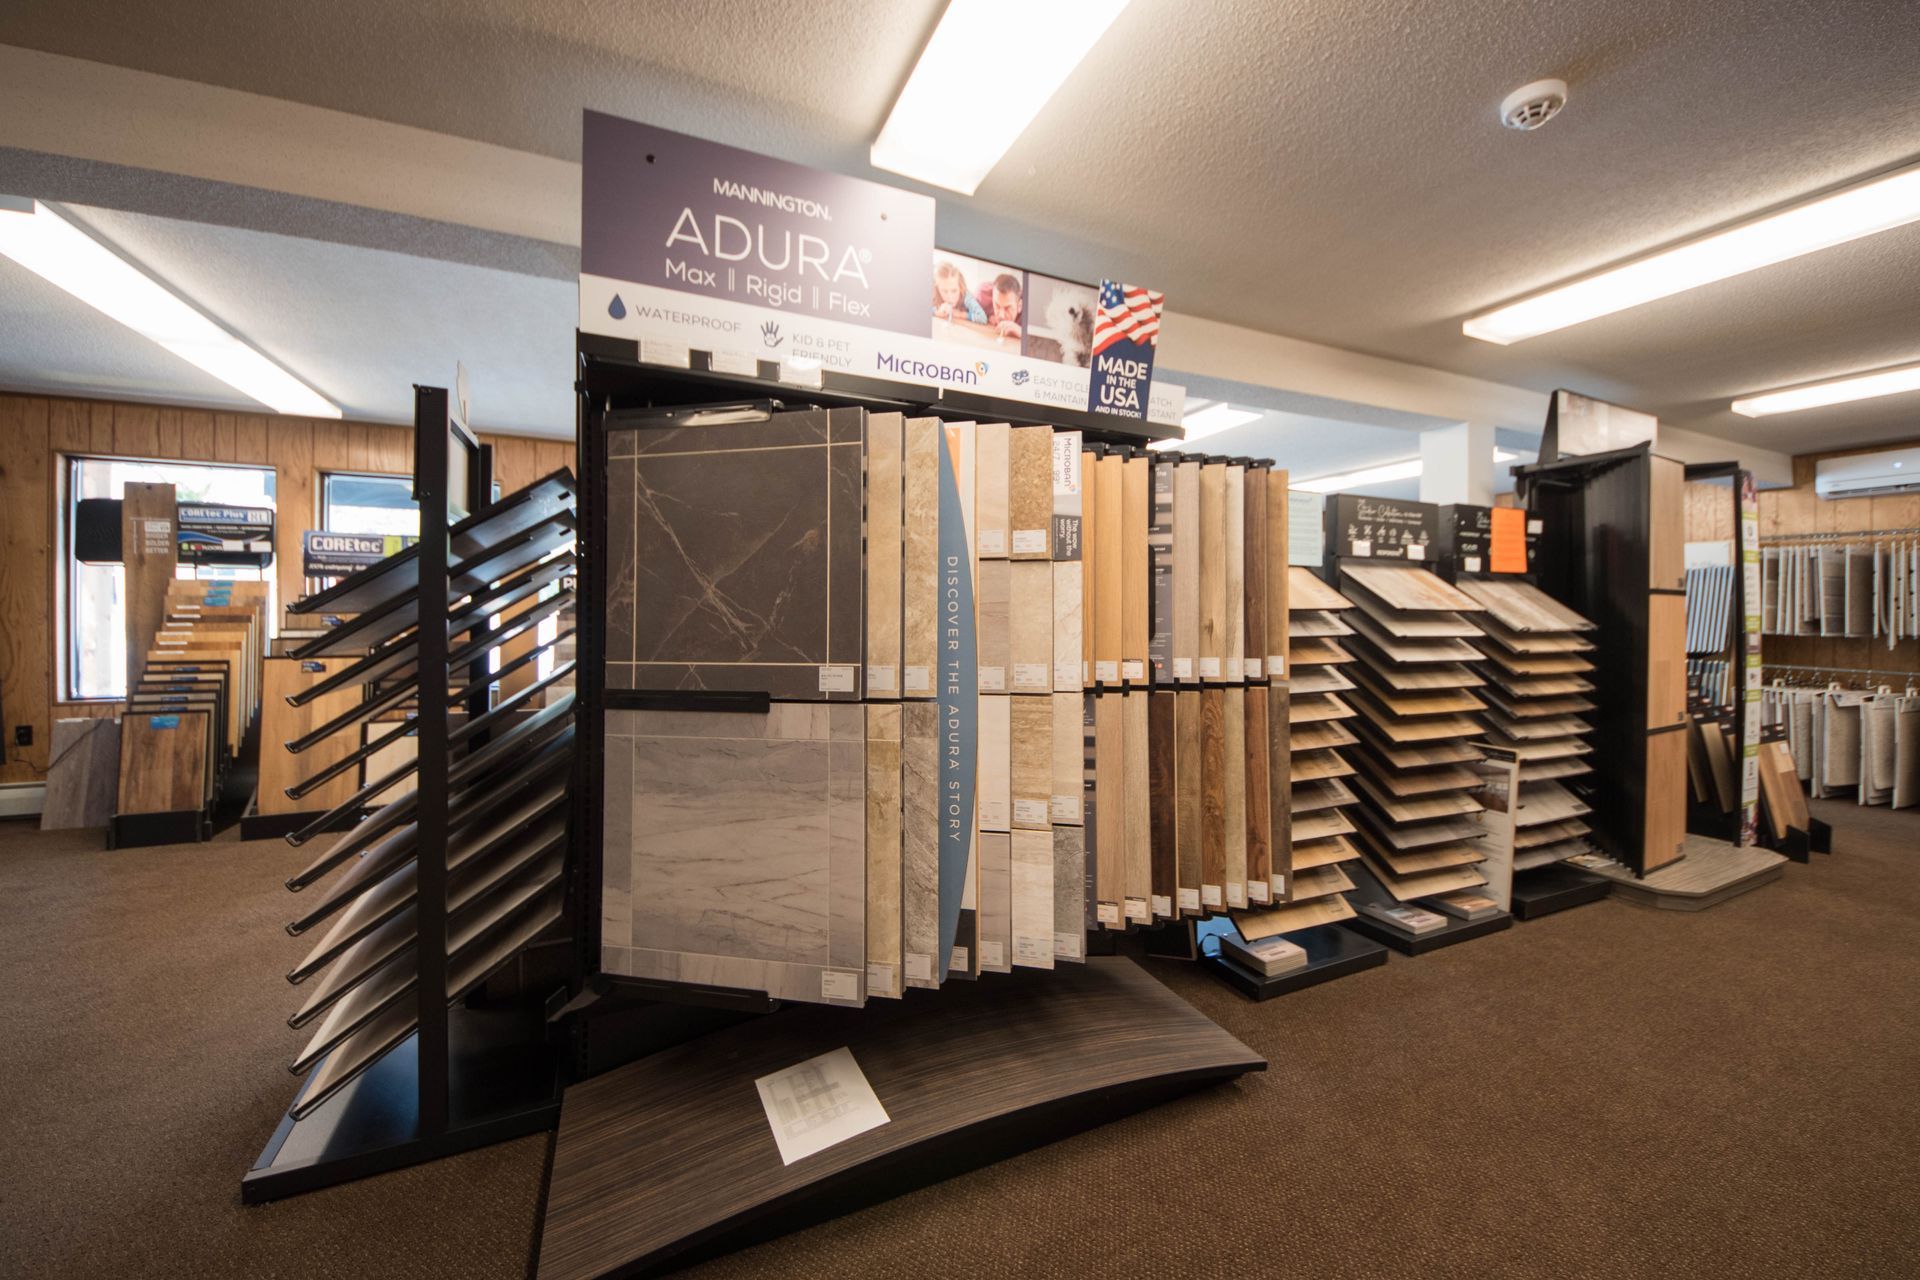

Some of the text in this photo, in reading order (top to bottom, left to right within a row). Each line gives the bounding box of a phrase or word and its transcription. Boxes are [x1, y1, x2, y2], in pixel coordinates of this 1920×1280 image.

[665, 258, 871, 317] Max Rigid Flex
[636, 305, 742, 333] WATERPROOF
[792, 333, 814, 346] KID
[828, 338, 850, 352] PET
[1098, 355, 1148, 380] MADE
[1033, 375, 1058, 388] EASY
[1061, 380, 1073, 390] TO
[1106, 375, 1137, 389] IN THE
[1043, 391, 1087, 405] MAINTAIN
[1100, 384, 1140, 409] USA
[1095, 405, 1141, 419] AND IN STOCK!
[310, 536, 382, 553] COREtec
[947, 556, 959, 650] DISCOVER
[948, 660, 960, 695] THE
[949, 781, 961, 843] STORY
